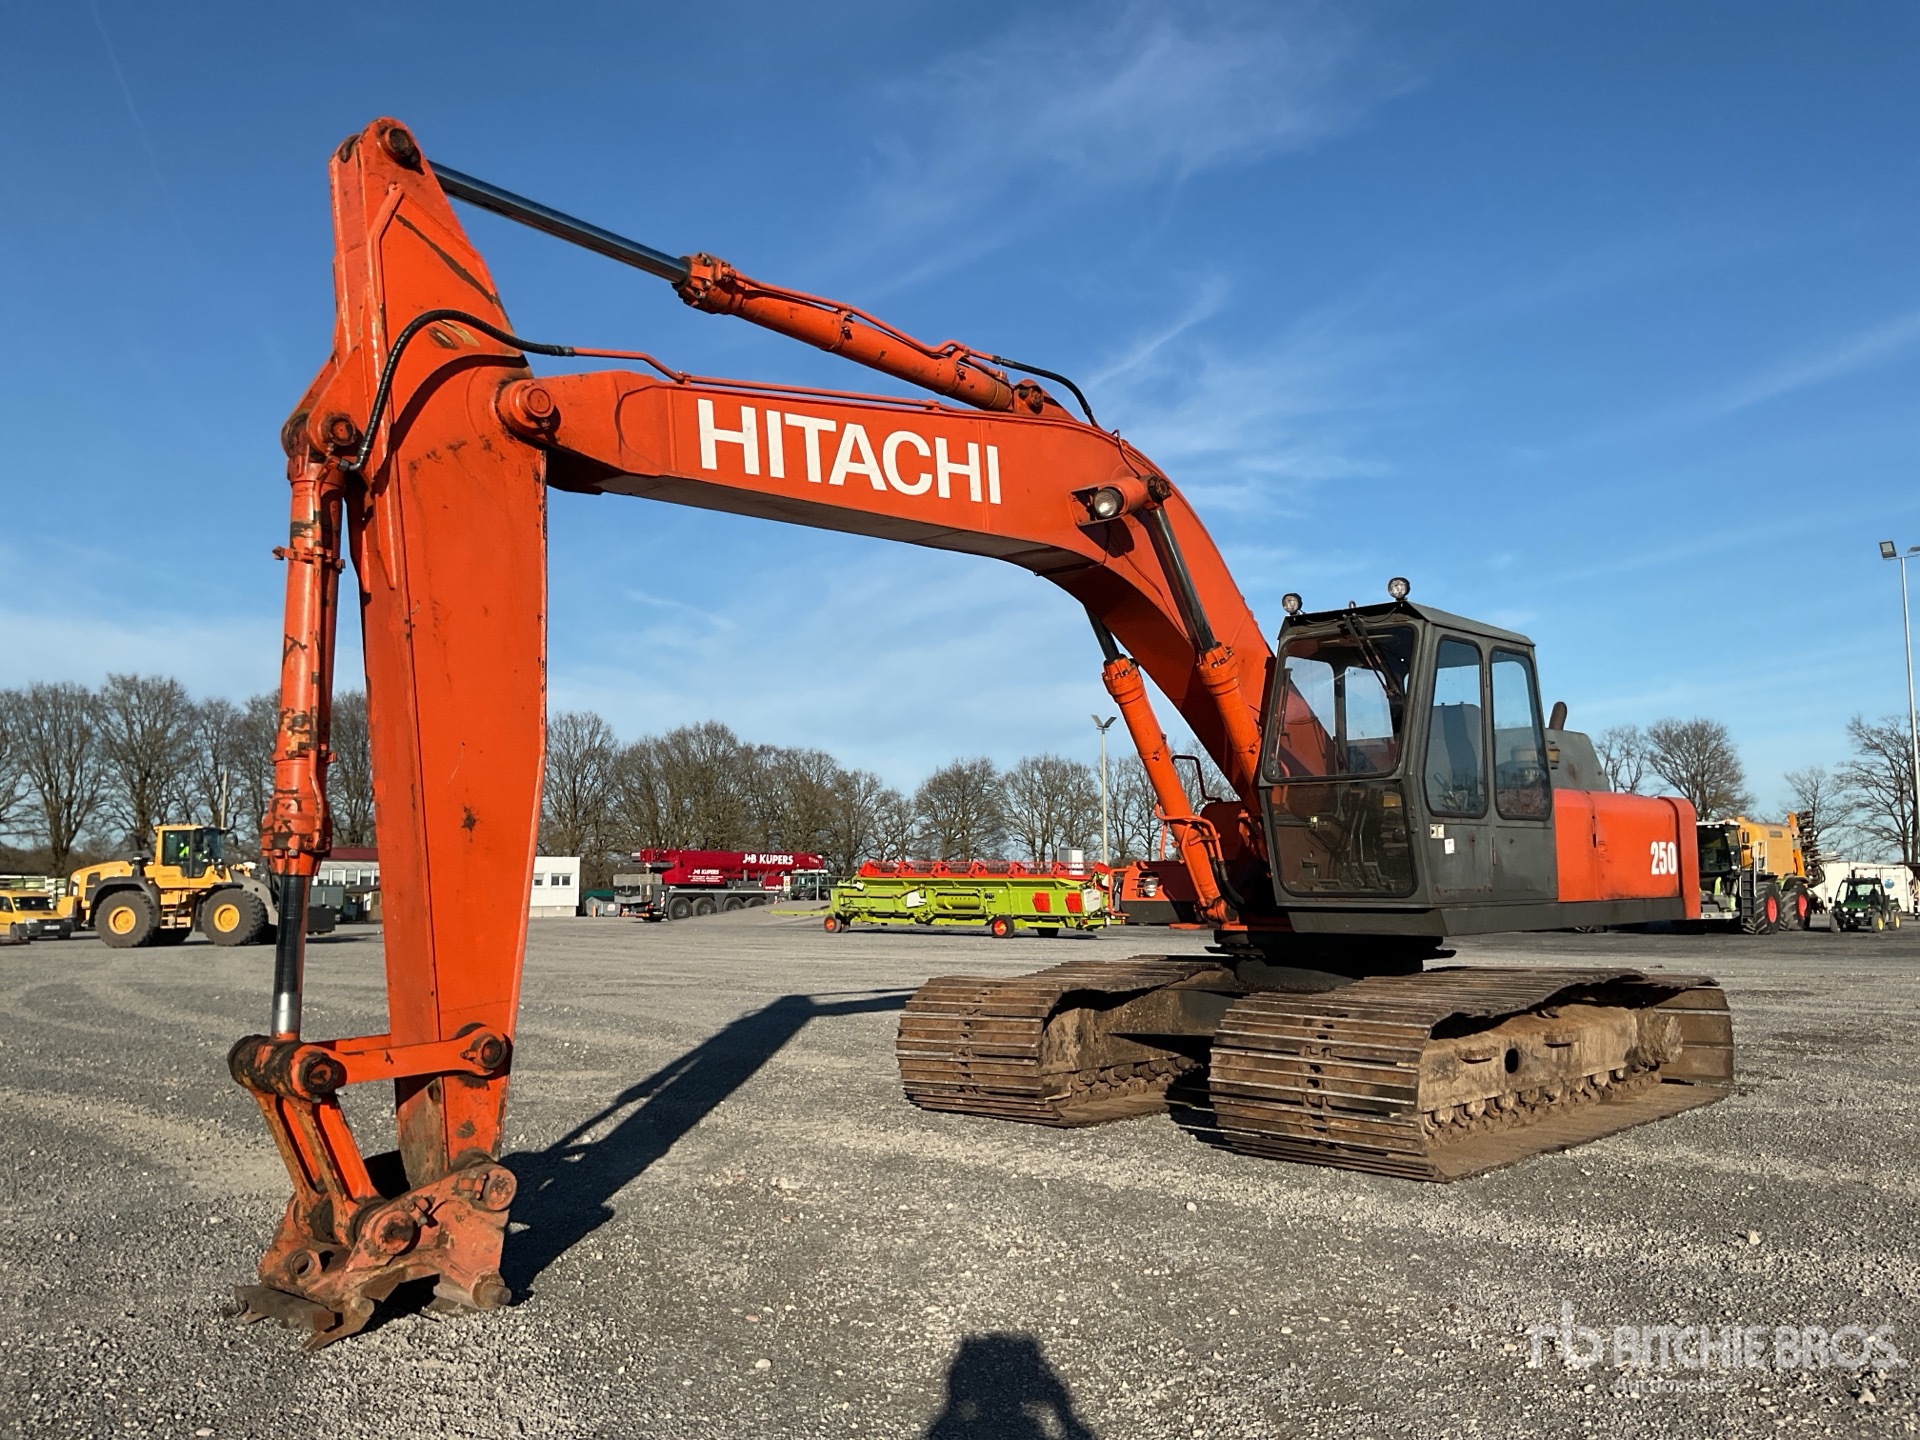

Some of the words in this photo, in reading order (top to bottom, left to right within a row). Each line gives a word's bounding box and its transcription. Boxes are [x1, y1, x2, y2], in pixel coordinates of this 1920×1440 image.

[697, 398, 1002, 505] HITACHI
[759, 854, 794, 865] KUPERS
[1650, 841, 1678, 875] 250
